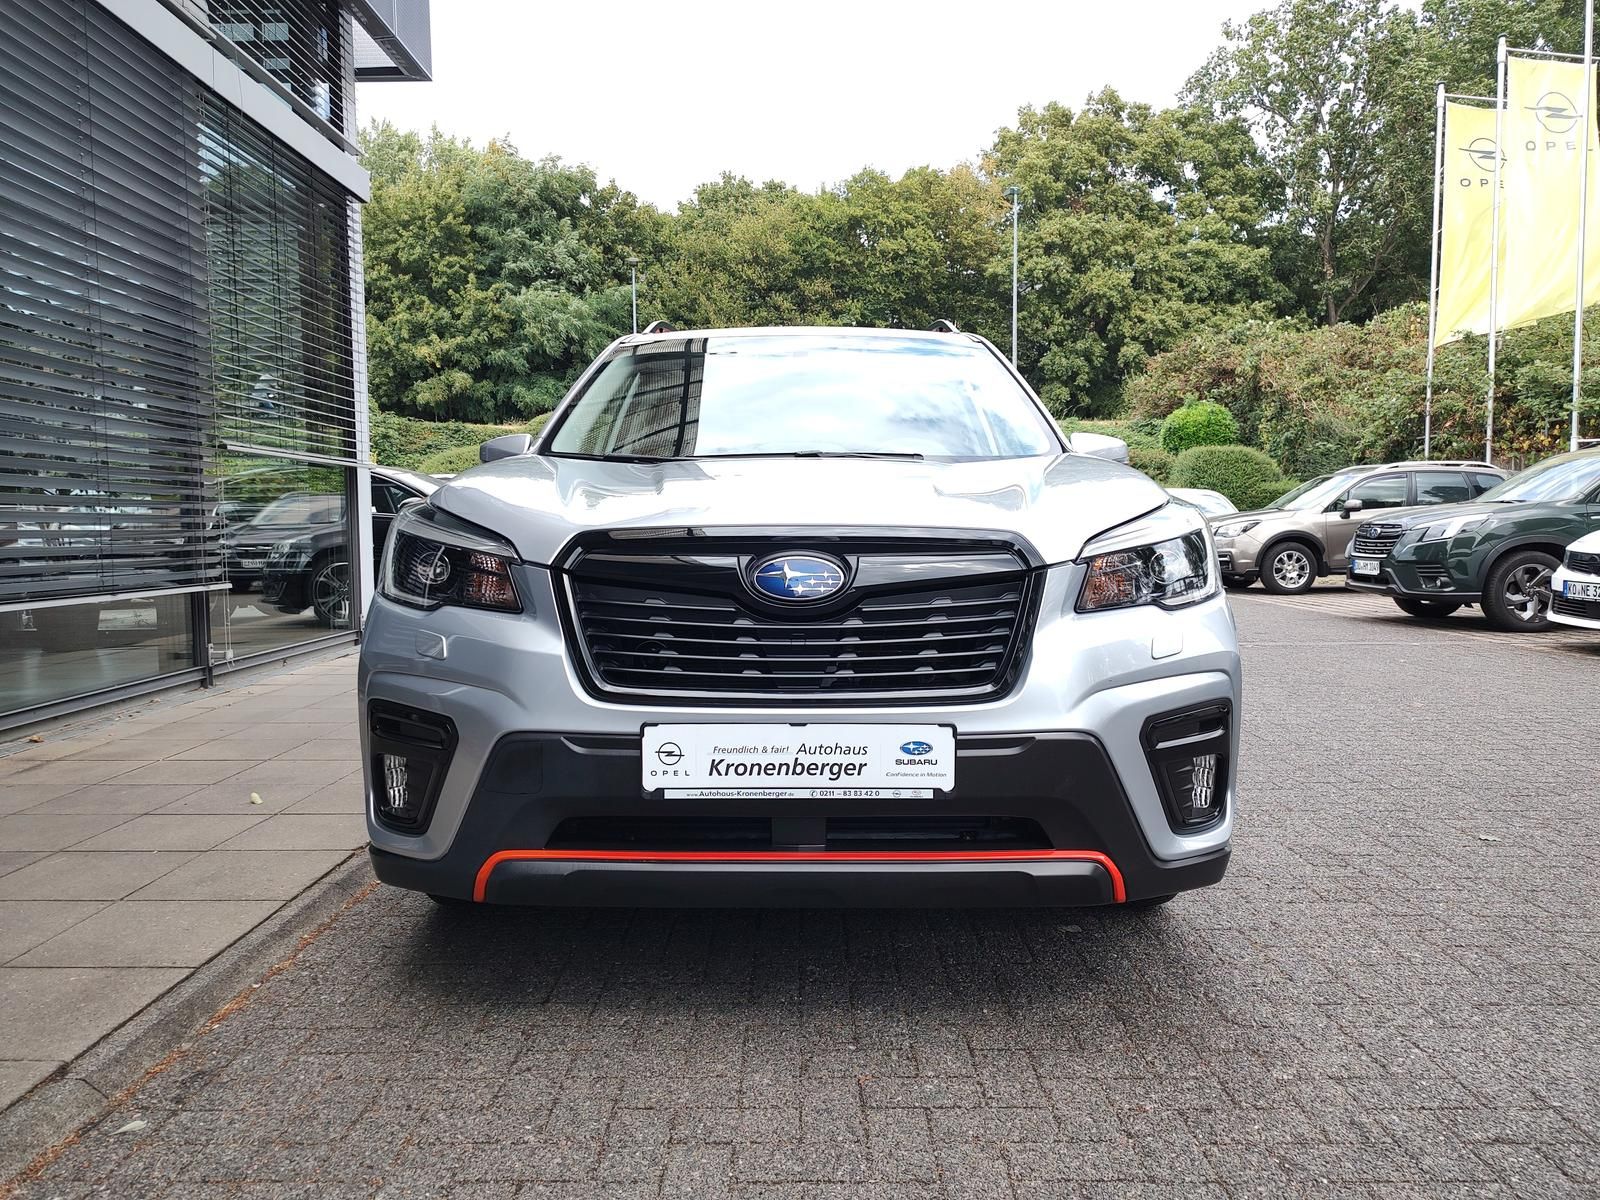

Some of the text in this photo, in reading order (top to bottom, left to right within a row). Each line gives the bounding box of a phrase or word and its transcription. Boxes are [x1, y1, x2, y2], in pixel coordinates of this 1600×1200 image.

[1525, 140, 1593, 152] OPE
[1460, 178, 1505, 189] OPE
[1568, 583, 1577, 595] KO
[1581, 584, 1590, 597] NE
[713, 743, 868, 756] Freundlich & fair! Autohaus
[895, 758, 938, 766] SUBARU
[708, 757, 867, 781] Kronenberger
